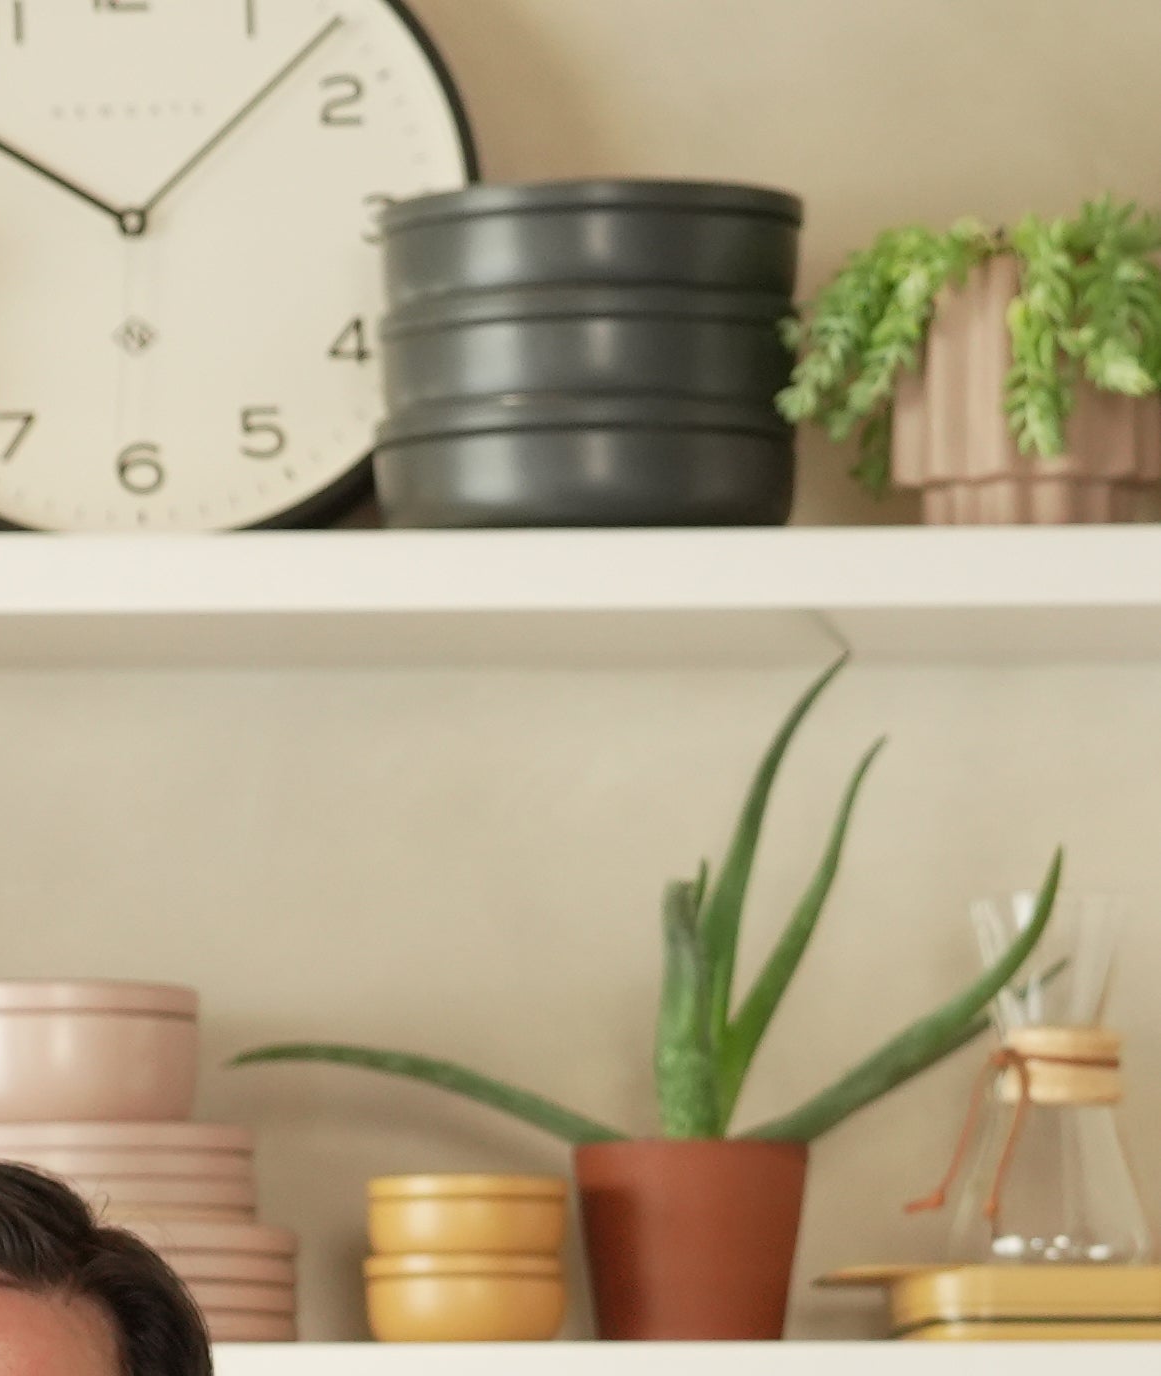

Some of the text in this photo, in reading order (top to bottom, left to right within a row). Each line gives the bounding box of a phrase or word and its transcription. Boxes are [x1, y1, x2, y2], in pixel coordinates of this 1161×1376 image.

[319, 74, 364, 126] 2
[328, 317, 372, 364] 4
[241, 408, 287, 459] 5
[117, 442, 166, 494] 6
